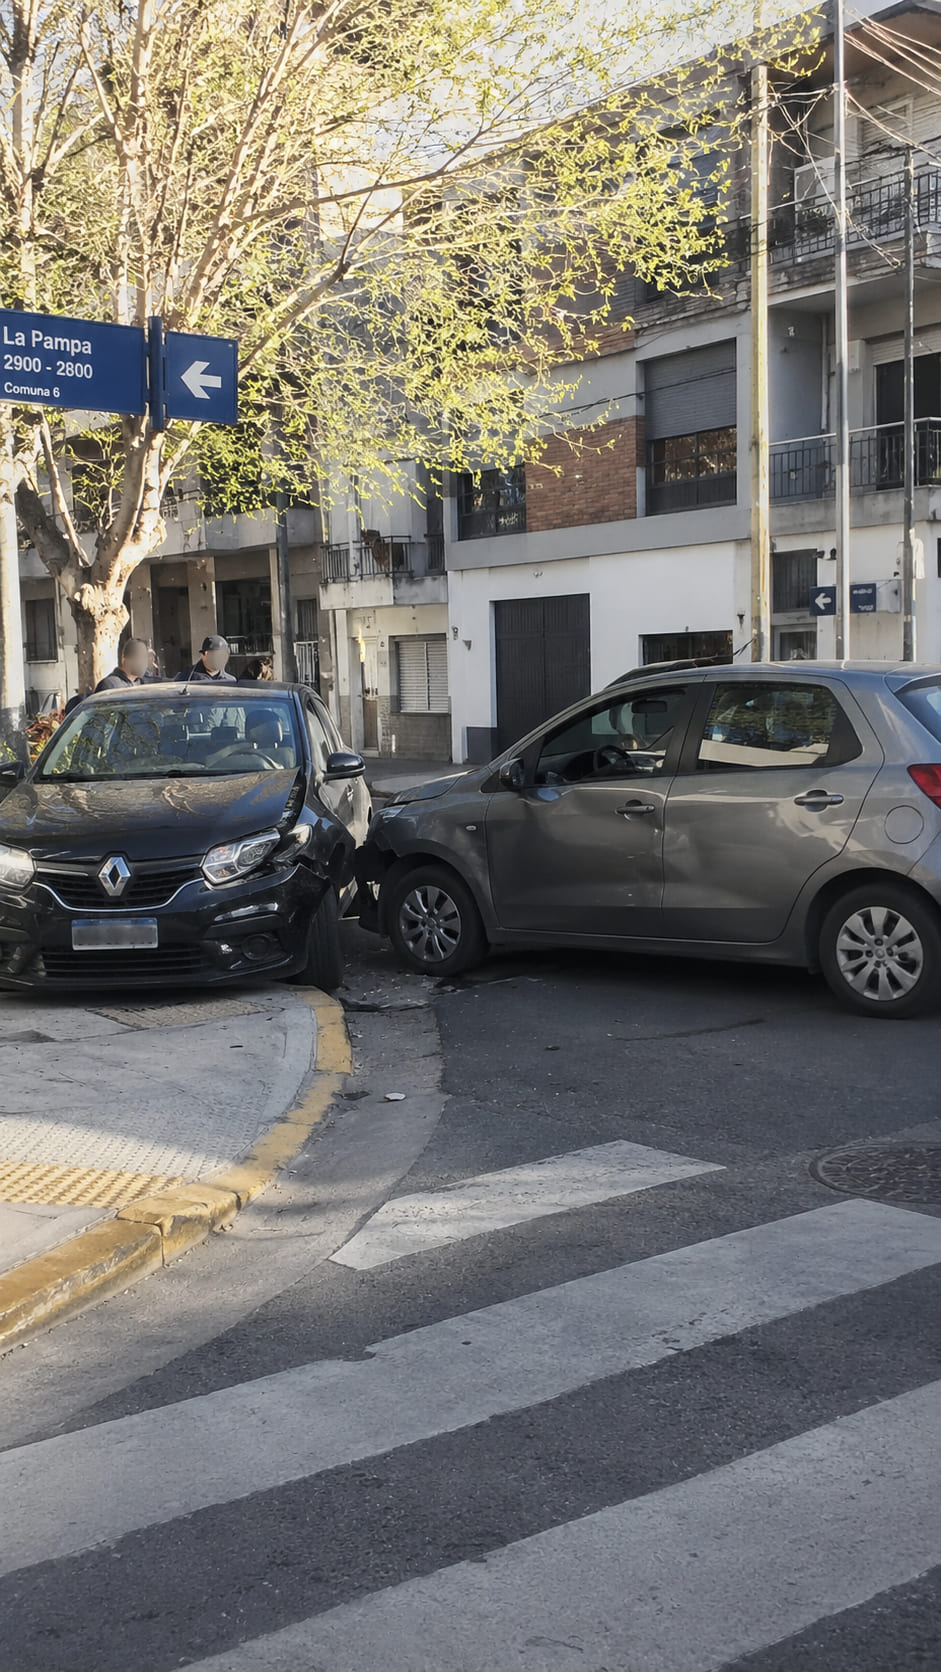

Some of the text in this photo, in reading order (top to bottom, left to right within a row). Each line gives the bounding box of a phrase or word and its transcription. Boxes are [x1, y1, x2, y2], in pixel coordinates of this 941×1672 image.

[3, 326, 92, 357] La Pampa
[3, 354, 42, 373] 2900
[56, 360, 93, 379] 2800
[4, 382, 60, 398] Comuna 6
